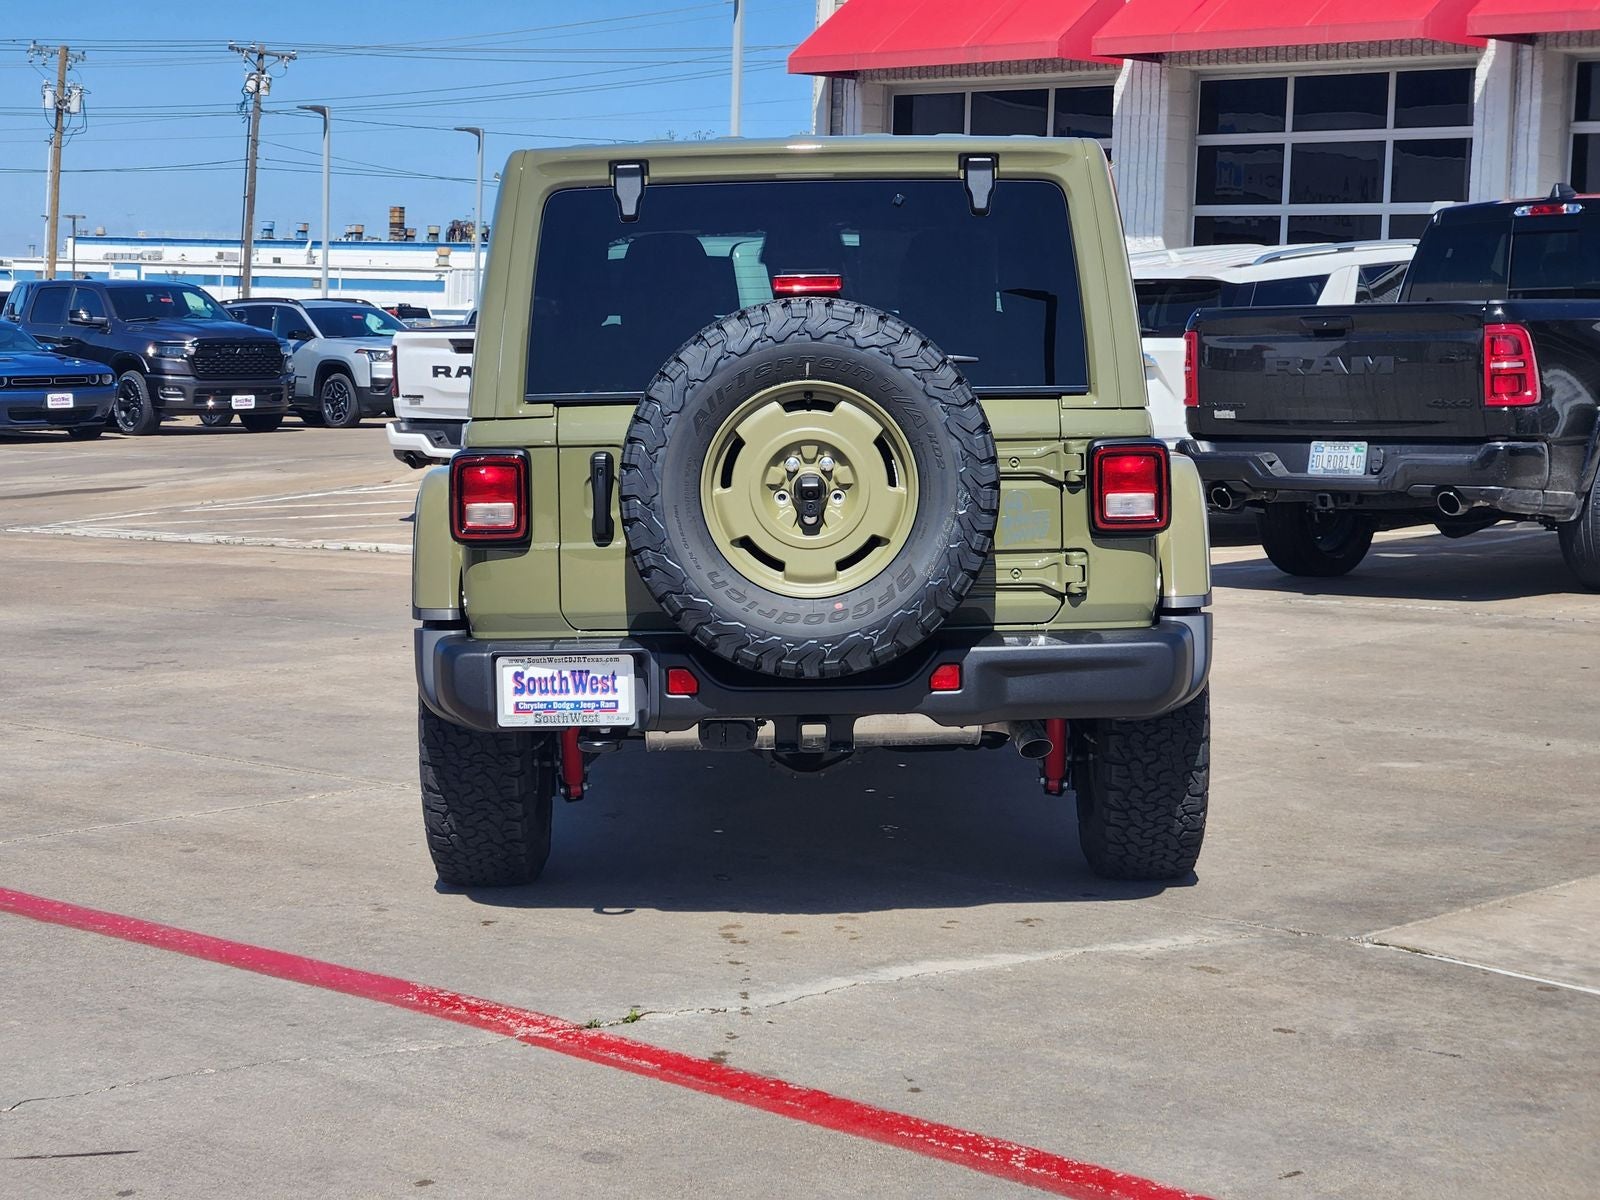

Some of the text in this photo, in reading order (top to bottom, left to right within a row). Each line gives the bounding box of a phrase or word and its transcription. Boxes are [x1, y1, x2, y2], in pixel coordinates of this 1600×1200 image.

[432, 365, 472, 378] RA
[1264, 356, 1395, 376] RAM
[707, 563, 917, 625] BFGoodrich
[512, 670, 618, 696] SouthWest
[518, 700, 616, 711] Chrysler Dodge Jeep Ram
[534, 712, 600, 724] SouthWest
